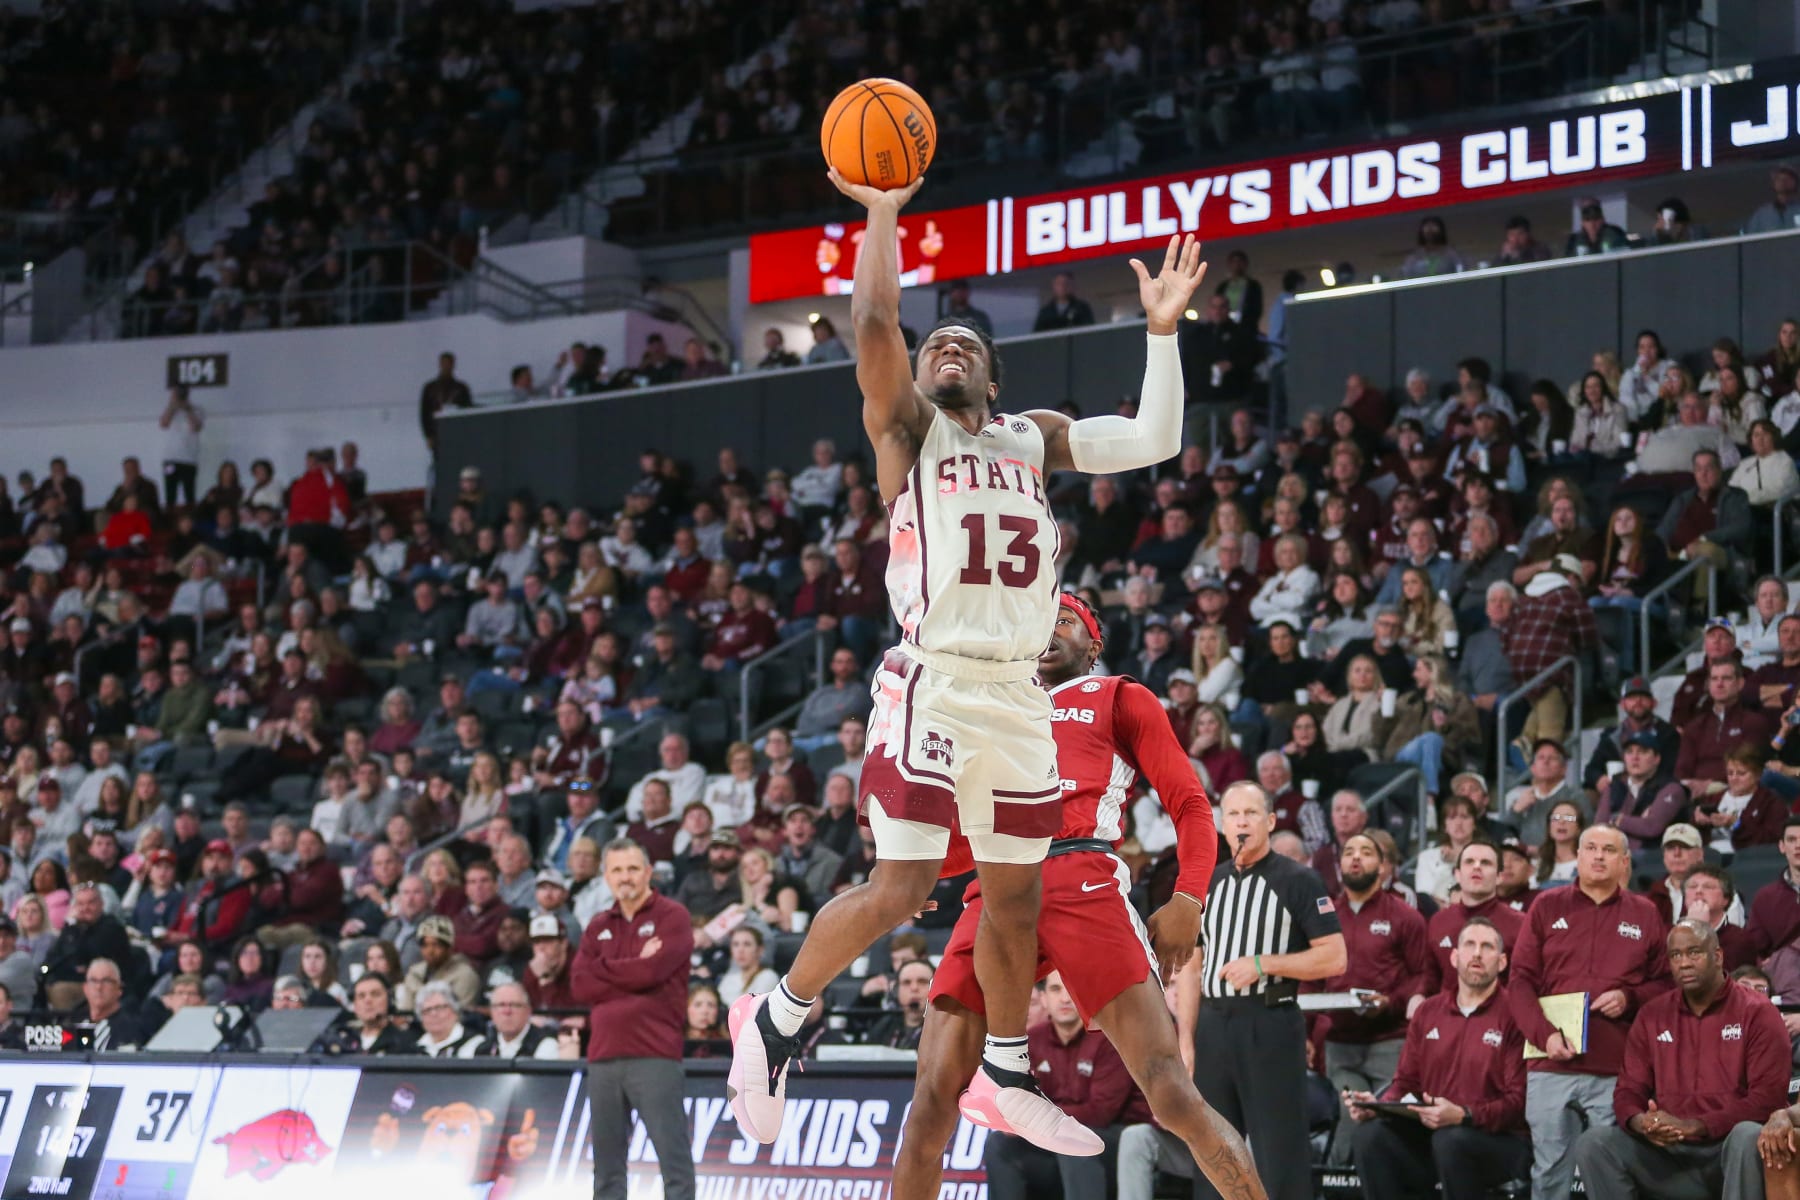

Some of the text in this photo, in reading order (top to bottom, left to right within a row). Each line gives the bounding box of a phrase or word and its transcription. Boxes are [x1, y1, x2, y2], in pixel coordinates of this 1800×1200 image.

[1731, 83, 1800, 147] J
[1026, 108, 1647, 257] BULLY'S KIDS CLUB
[179, 358, 216, 384] 104
[938, 454, 1045, 507] STATE
[959, 513, 1041, 588] 13
[25, 1025, 63, 1045] POSS
[136, 1092, 193, 1142] 37
[769, 1098, 890, 1167] KIDS
